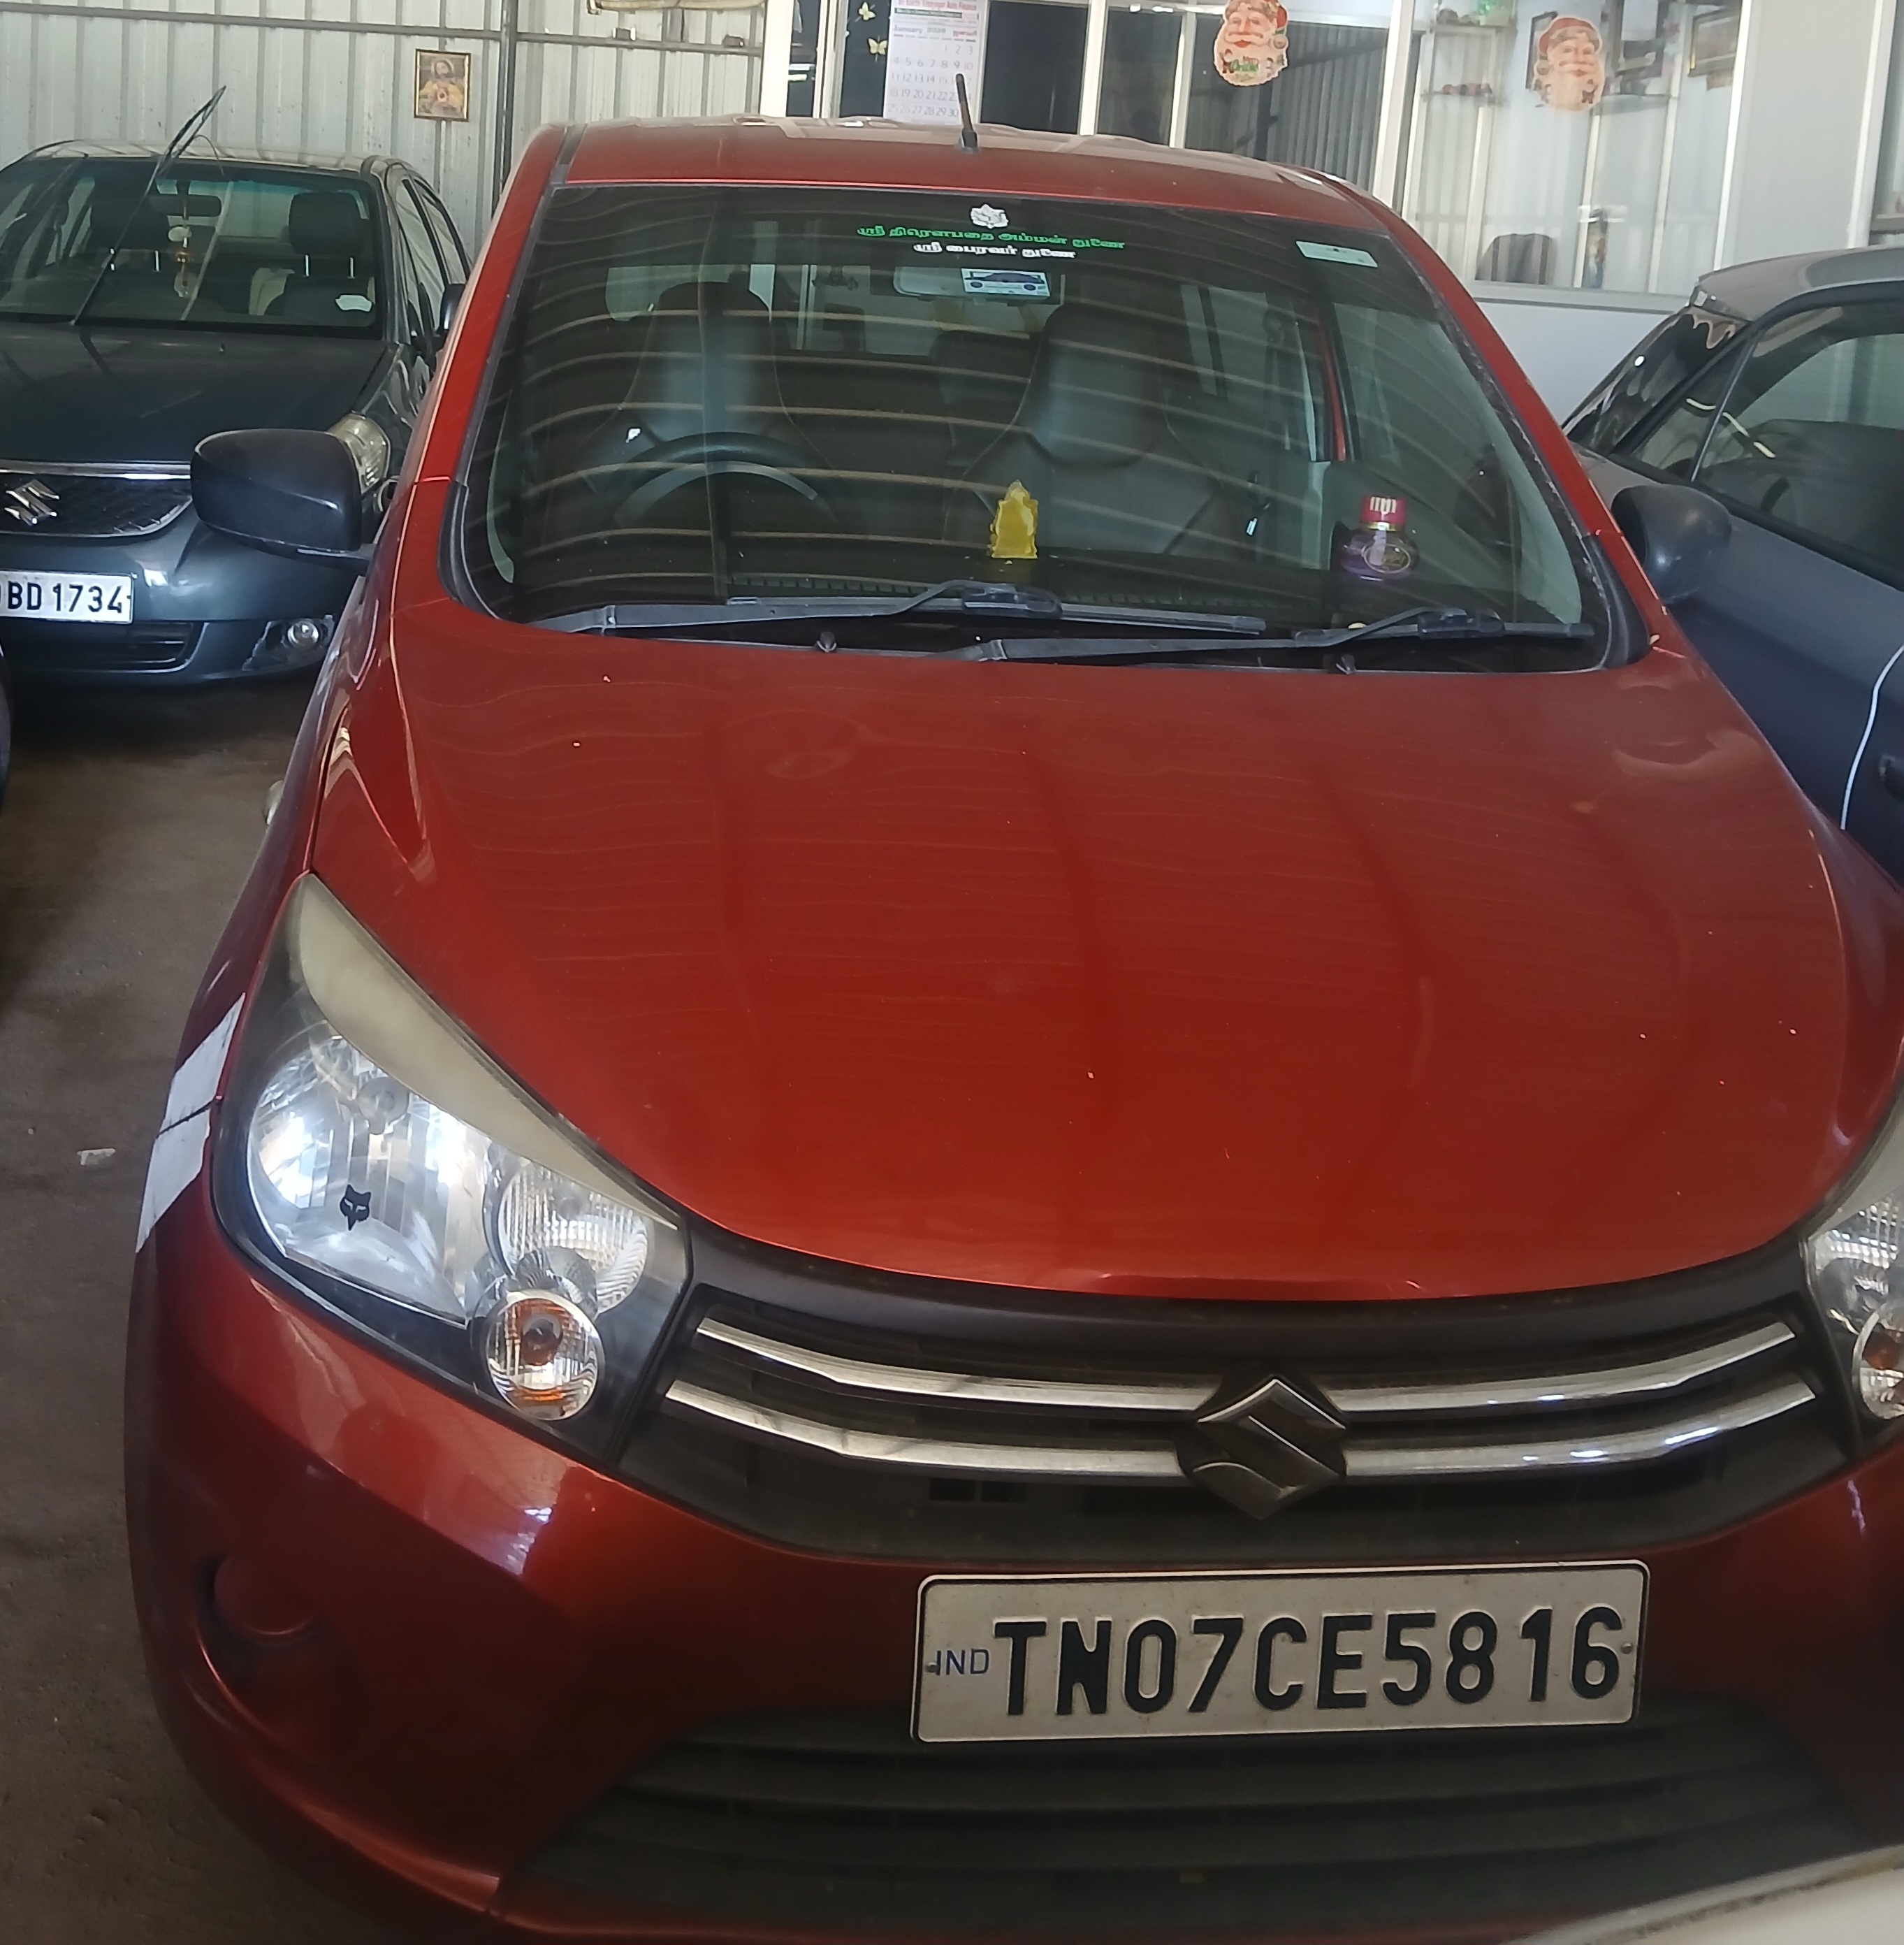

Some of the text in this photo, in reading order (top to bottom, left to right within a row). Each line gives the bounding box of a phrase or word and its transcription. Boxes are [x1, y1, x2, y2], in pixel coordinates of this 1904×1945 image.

[894, 24, 923, 34] January
[955, 45, 961, 55] 2
[968, 45, 973, 55] 3
[893, 57, 973, 71] 4 5 6 7 8 9 10
[891, 72, 899, 80] 11
[902, 73, 912, 82] 12
[915, 73, 924, 83] 13
[926, 75, 935, 83] 14
[938, 75, 947, 85] 15
[889, 88, 899, 97] 18
[901, 89, 911, 97] 19
[913, 89, 924, 99] 20
[925, 90, 936, 100] 21
[937, 91, 948, 101] 22
[888, 103, 899, 113] 25
[912, 105, 922, 115] 27
[924, 106, 935, 115] 28
[936, 107, 947, 116] 29
[947, 108, 959, 117] 30
[998, 232, 1068, 245] அம்மன்
[1072, 238, 1125, 249] துணை
[945, 245, 1018, 255] பைரவர்
[1022, 248, 1076, 259] துணை
[52, 582, 122, 614] 1734
[936, 1605, 1625, 1716] IND TN07CE5816
